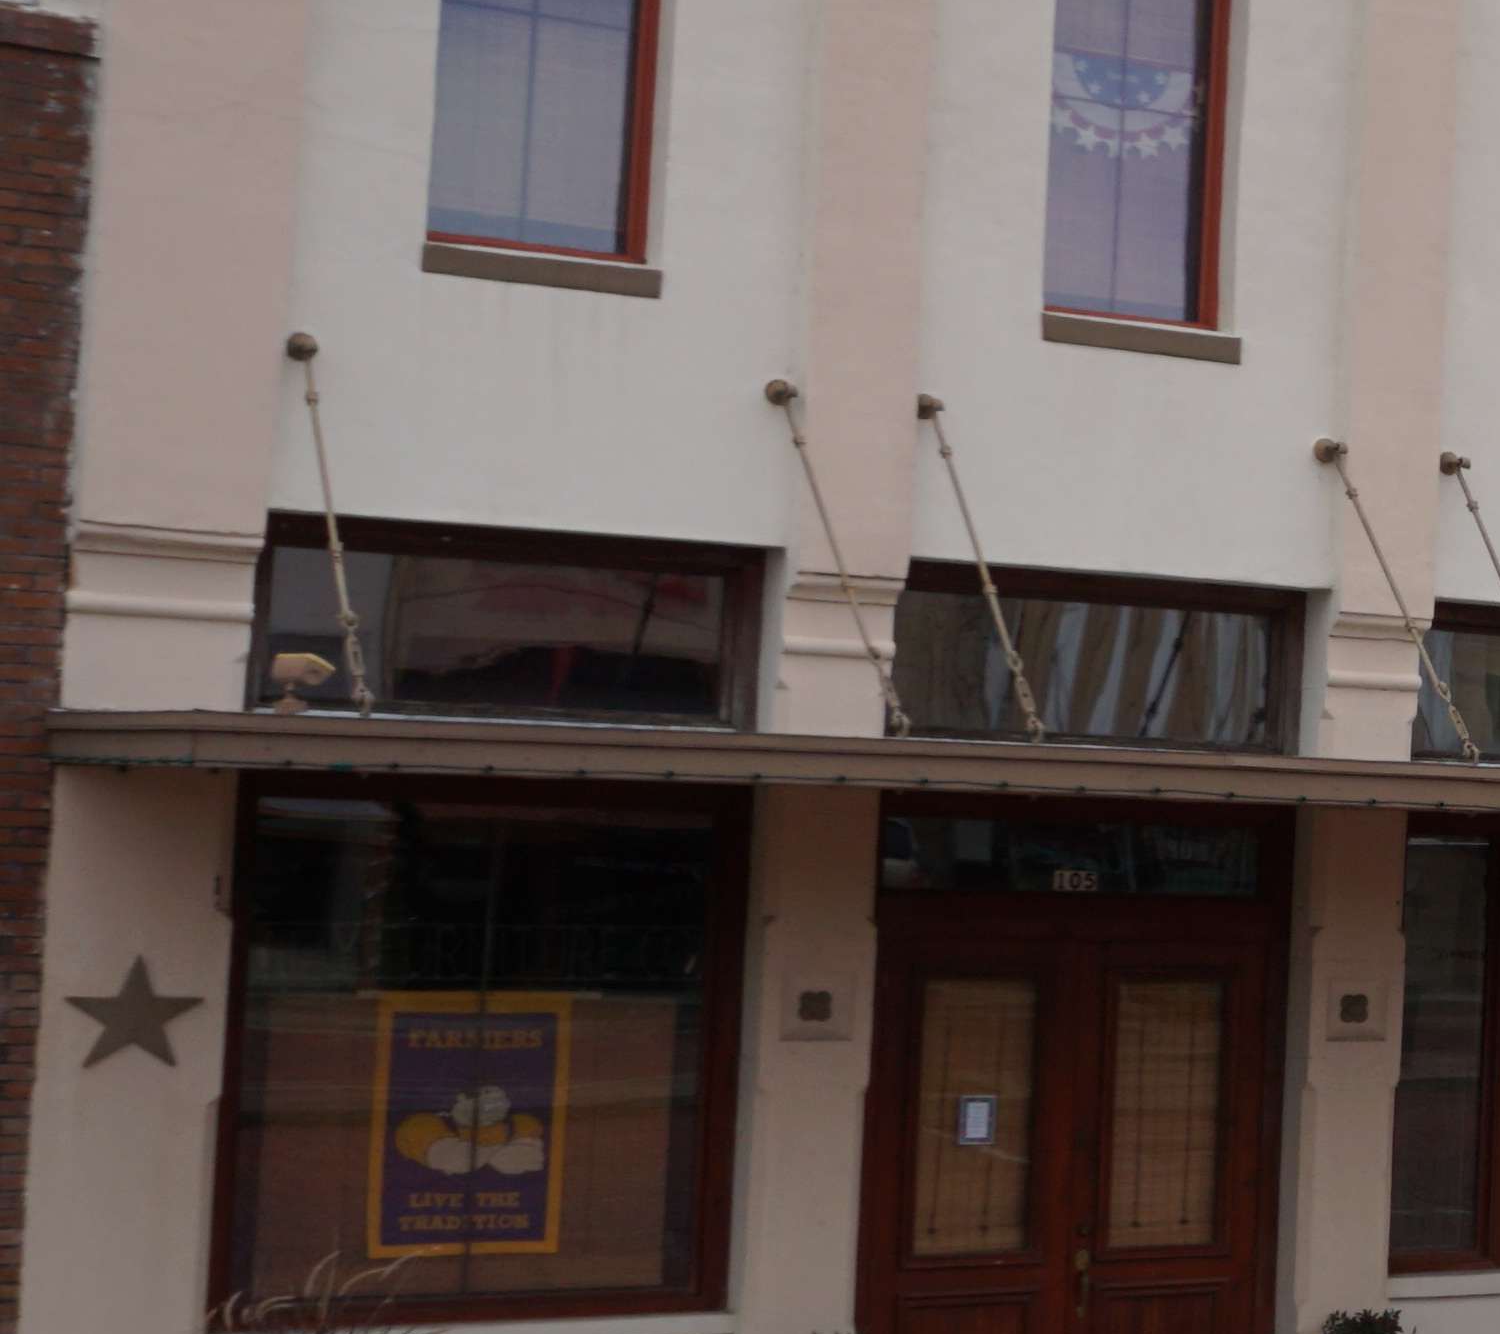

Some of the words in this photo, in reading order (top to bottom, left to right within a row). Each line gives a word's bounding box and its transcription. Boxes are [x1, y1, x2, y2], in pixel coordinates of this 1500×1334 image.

[1056, 872, 1097, 890] 105
[409, 1192, 466, 1209] LIVE
[475, 1191, 521, 1208] THE
